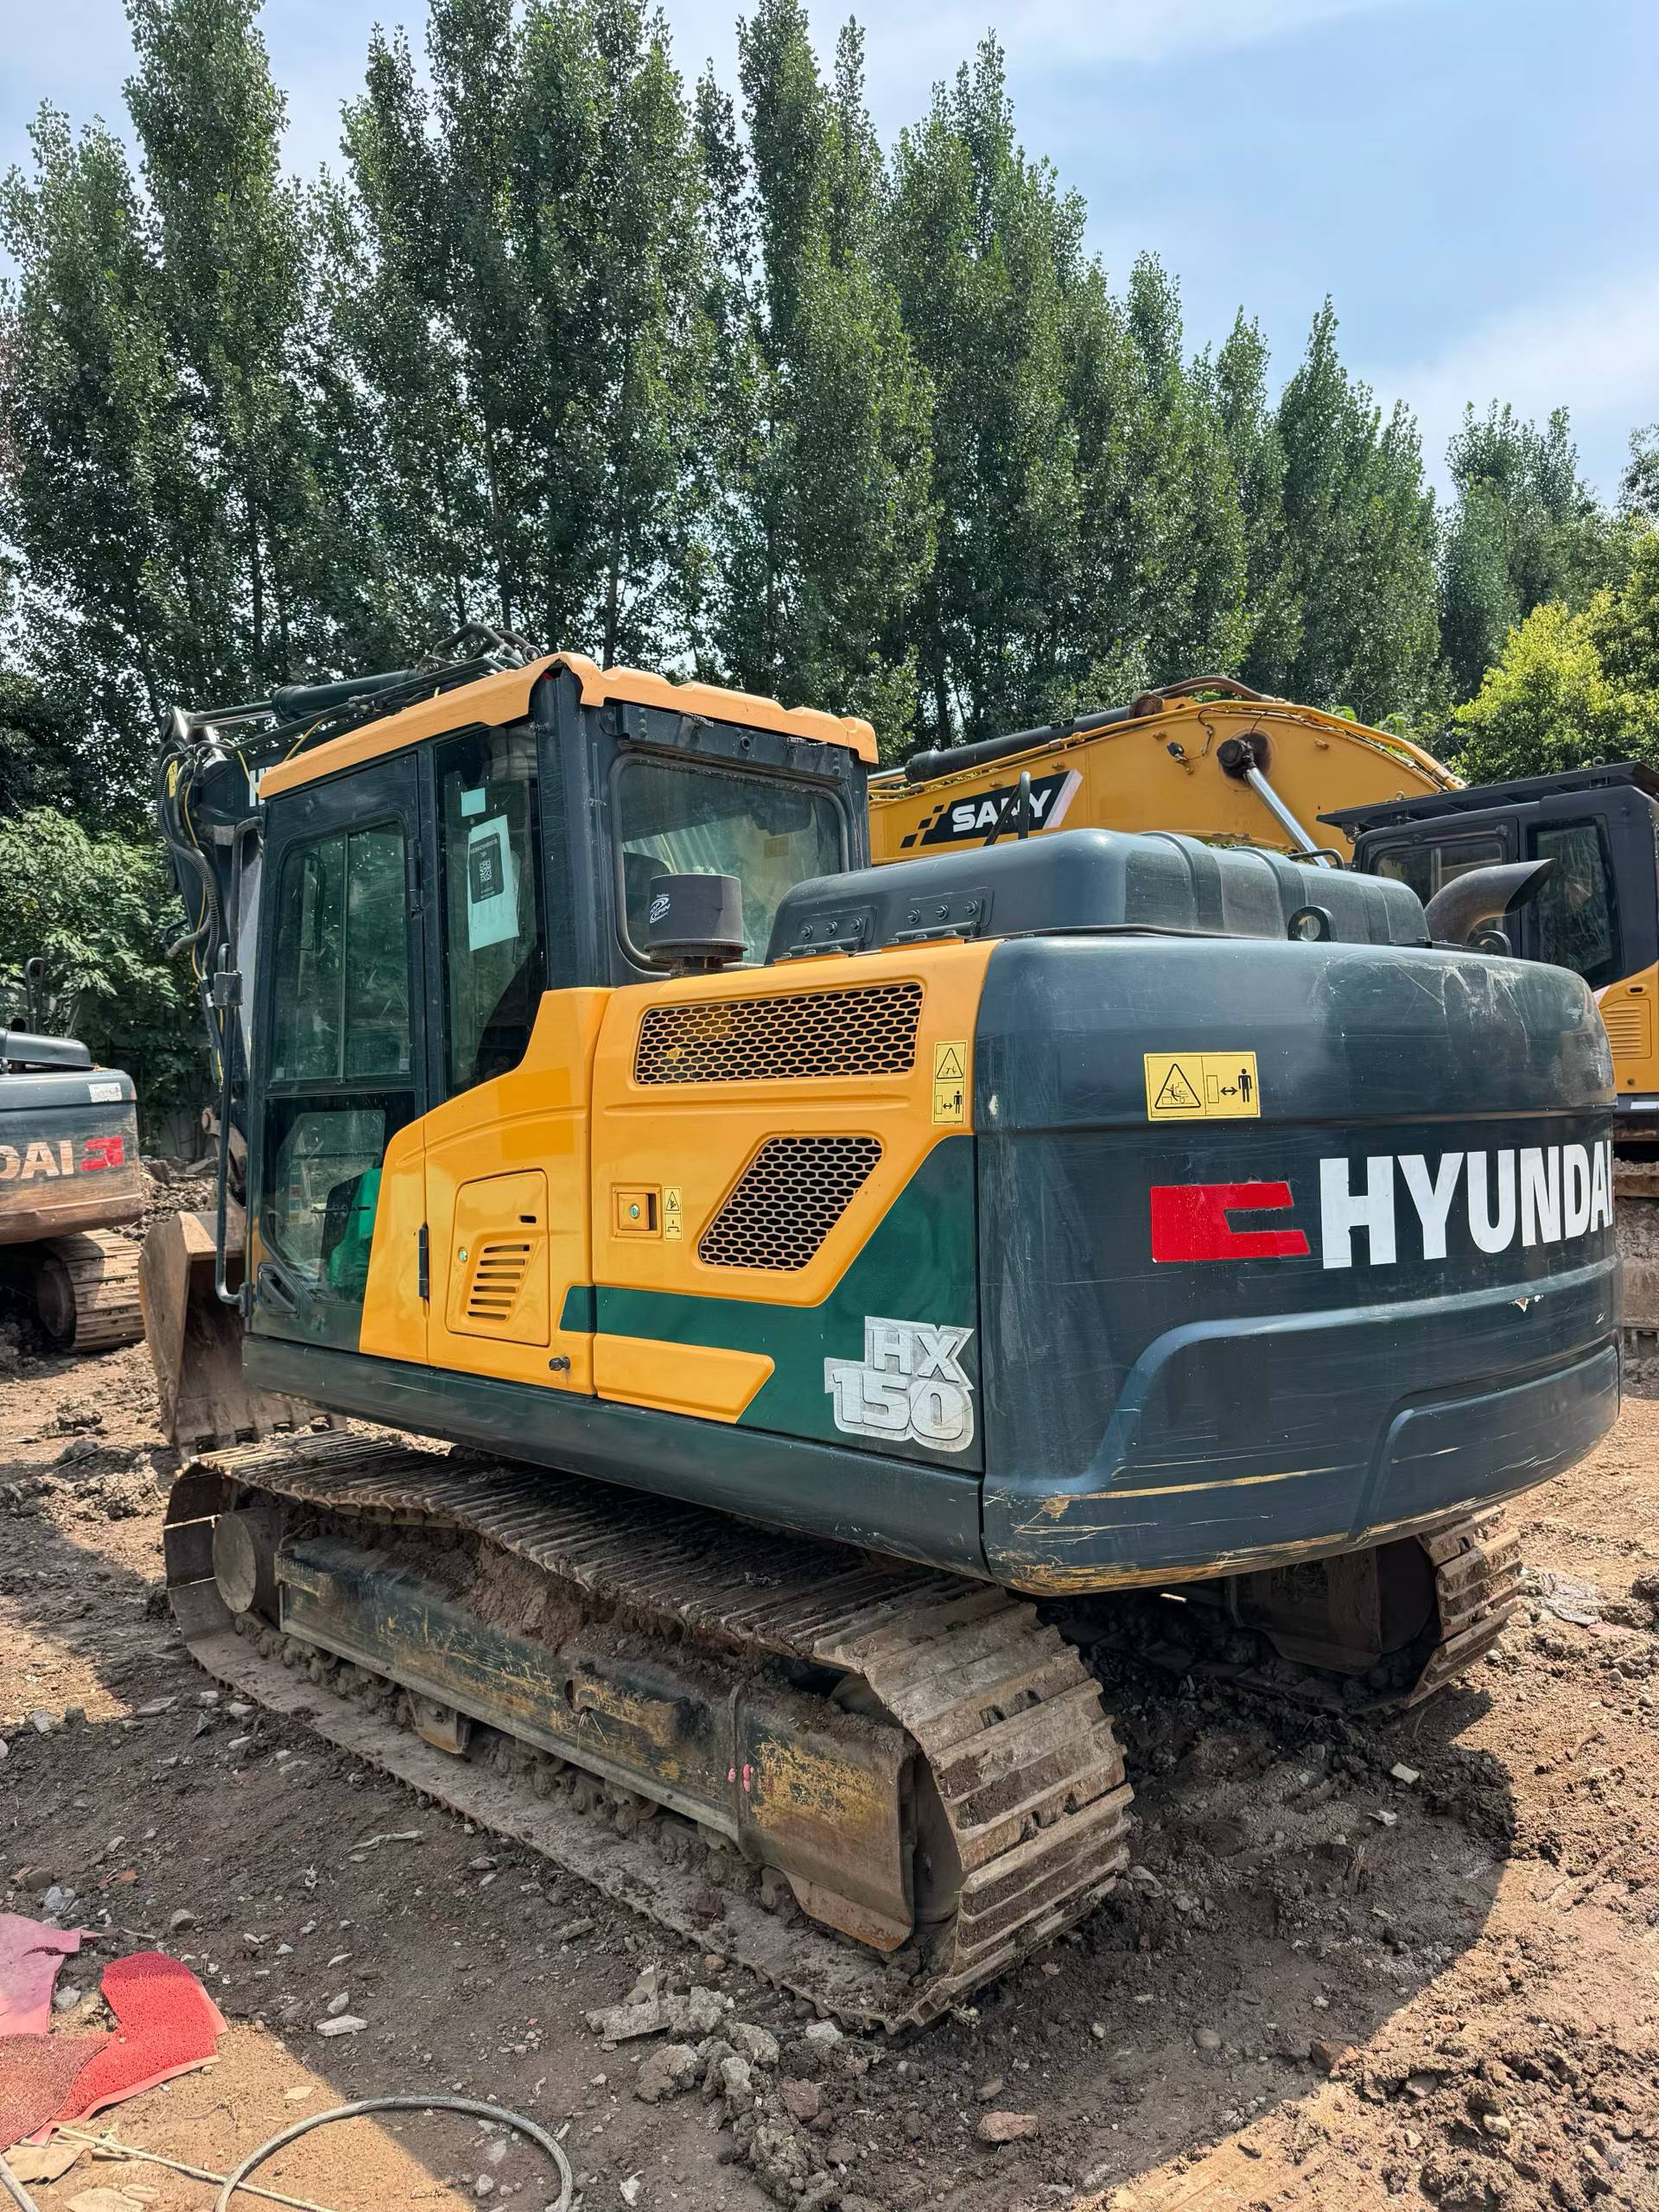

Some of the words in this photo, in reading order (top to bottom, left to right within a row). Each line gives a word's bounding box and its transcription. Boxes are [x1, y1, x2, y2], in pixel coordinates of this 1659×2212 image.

[1319, 1140, 1613, 1269] HYUNDAI
[869, 1325, 965, 1385] HX
[829, 1364, 968, 1445] 150
